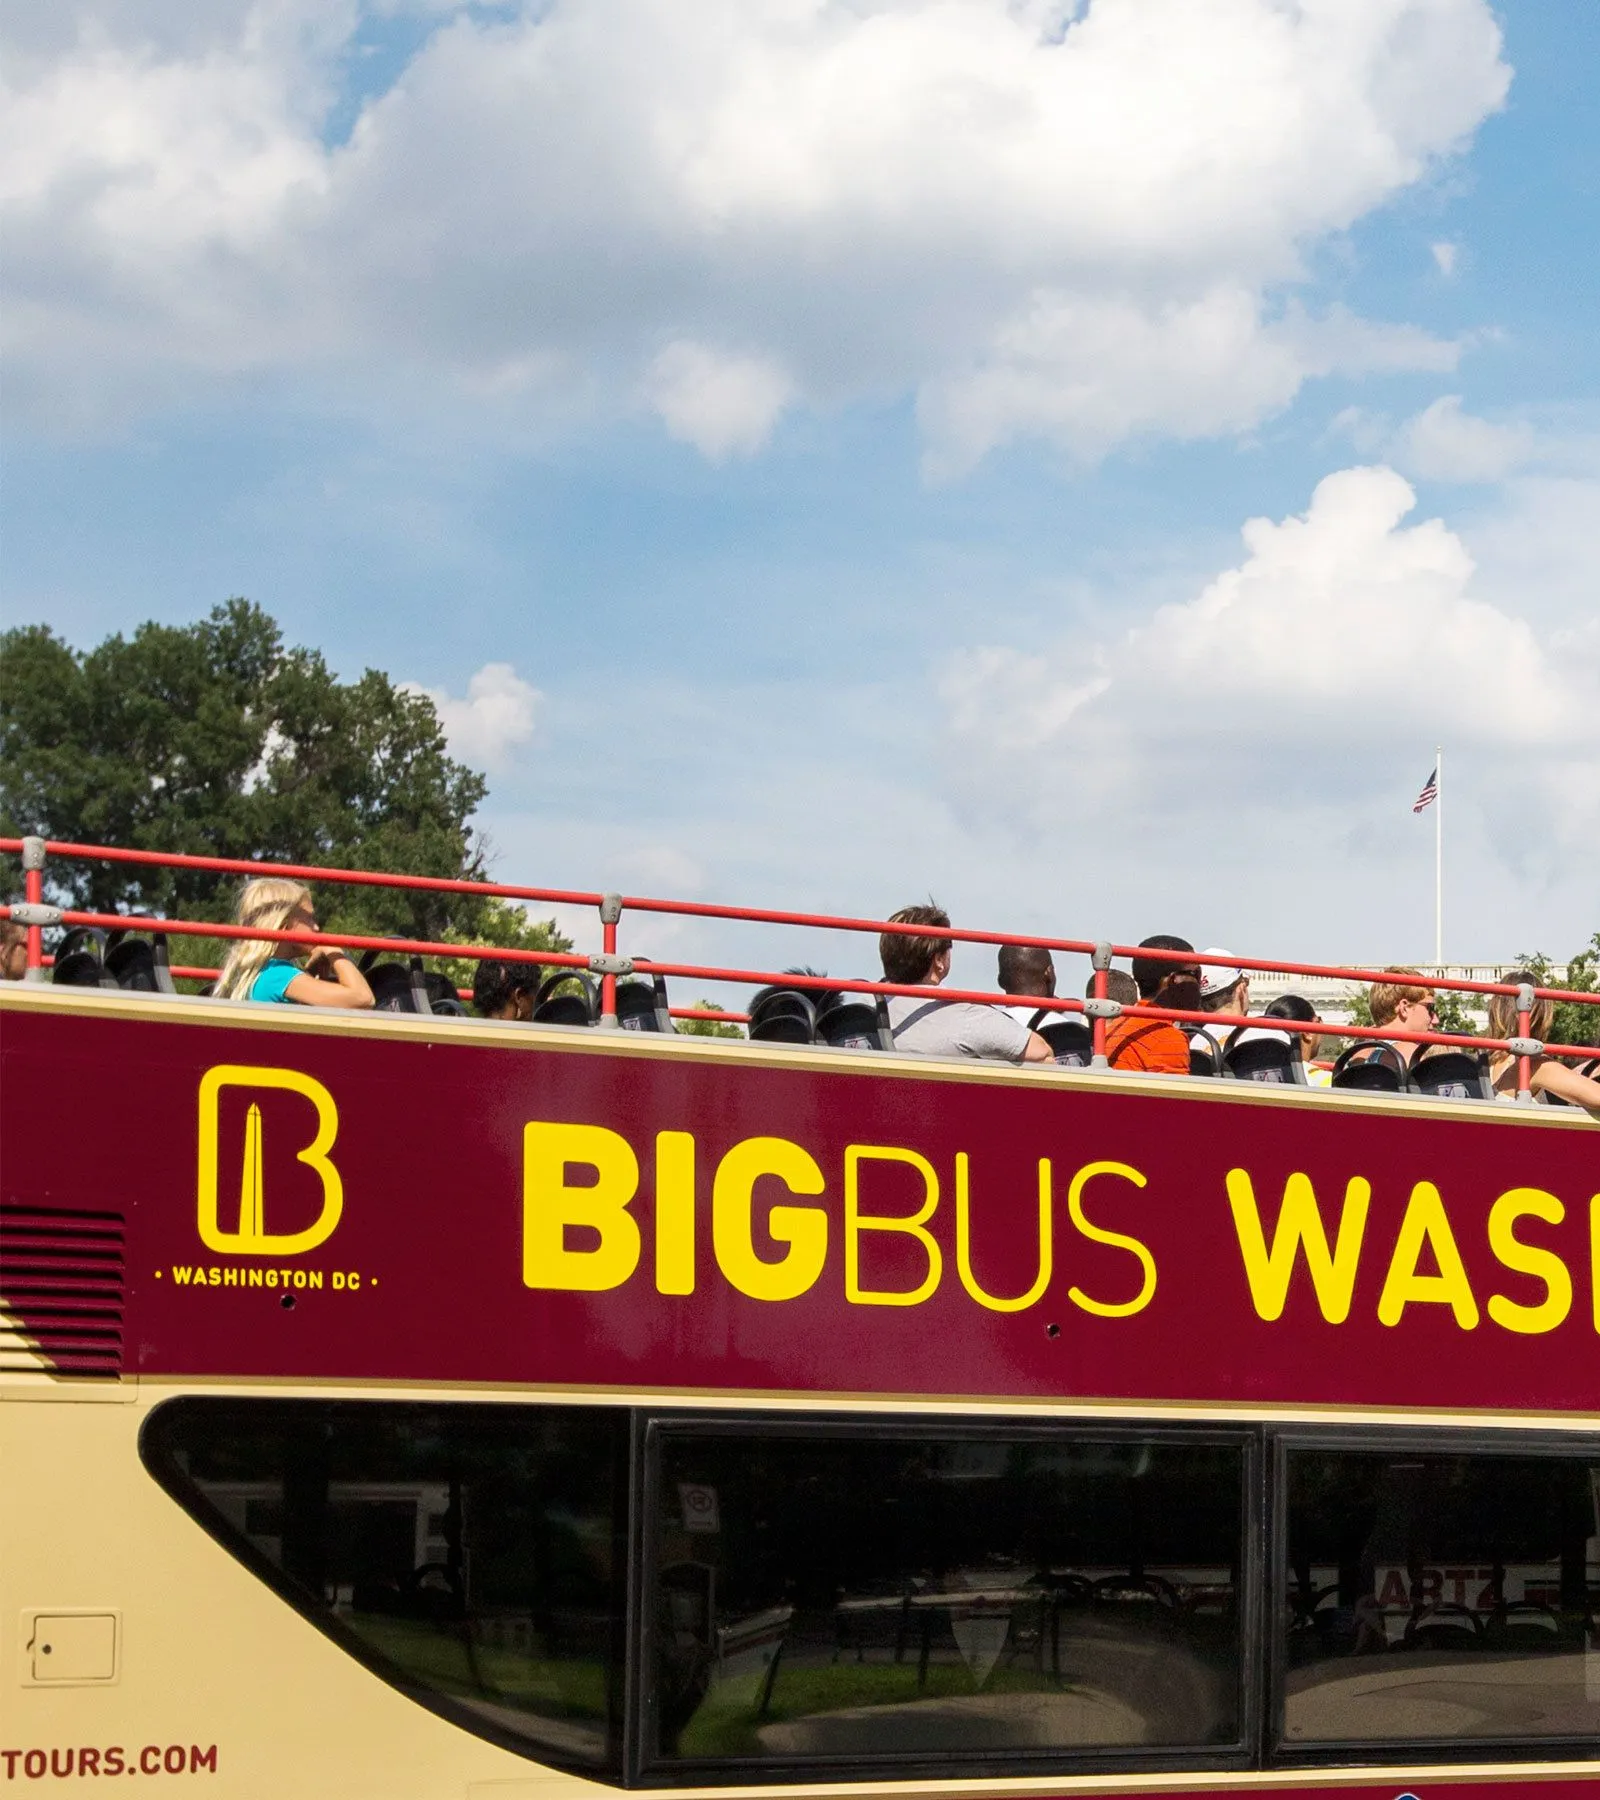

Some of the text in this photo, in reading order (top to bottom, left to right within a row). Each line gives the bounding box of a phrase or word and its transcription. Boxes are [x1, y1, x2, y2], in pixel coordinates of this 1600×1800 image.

[173, 1266, 361, 1290] WASHINGTON DC
[0, 1744, 217, 1780] TOURS.COM
